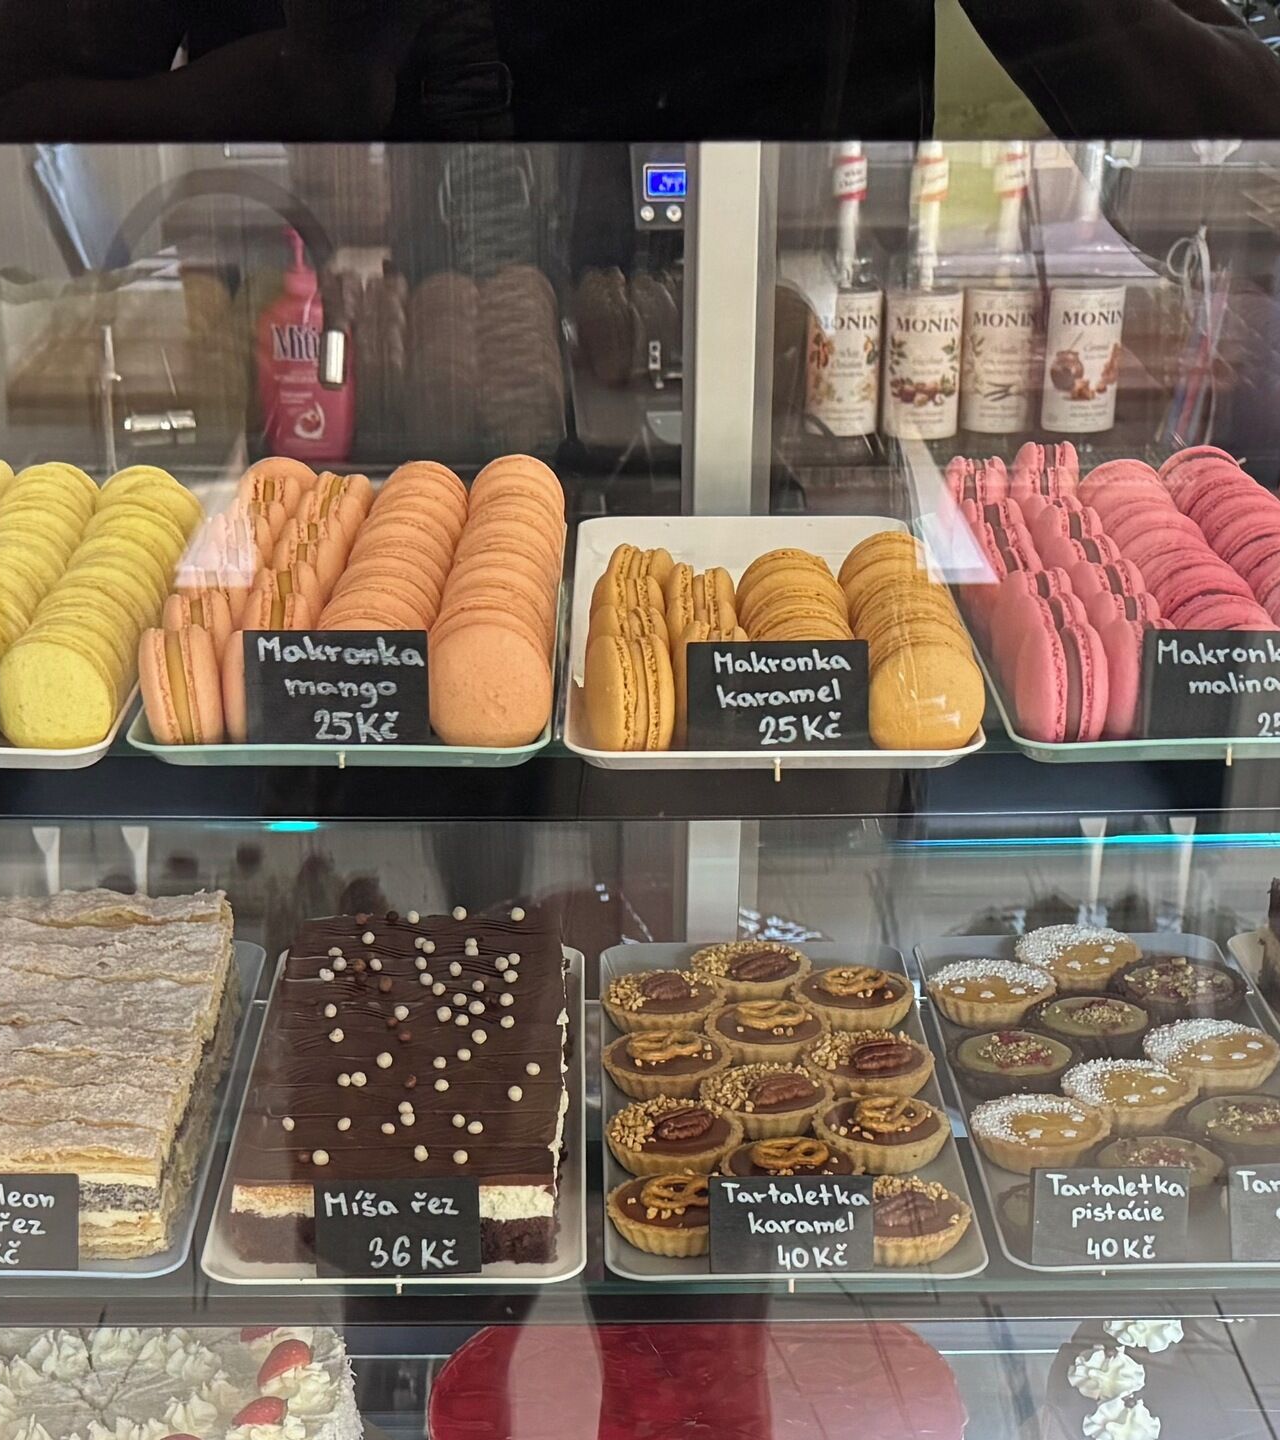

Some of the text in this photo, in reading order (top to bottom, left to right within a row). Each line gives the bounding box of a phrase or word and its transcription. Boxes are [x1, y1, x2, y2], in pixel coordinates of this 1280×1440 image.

[895, 315, 960, 333] MONIN
[972, 310, 1037, 329] MONIN
[256, 635, 425, 668] Makronka
[712, 648, 852, 675] Makronka
[283, 677, 398, 709] mango
[715, 677, 842, 709] karamel
[757, 710, 843, 746] 25 Kč
[720, 1181, 870, 1207] Tartaletka
[1044, 1172, 1187, 1198] Tartaletka
[323, 1189, 460, 1218] Míša řez
[1071, 1199, 1165, 1229] pistácie
[747, 1211, 855, 1235] karamel
[368, 1234, 460, 1271] 36 Kč
[777, 1242, 848, 1271] 40 Kč
[1086, 1234, 1157, 1261] 40 Kč
